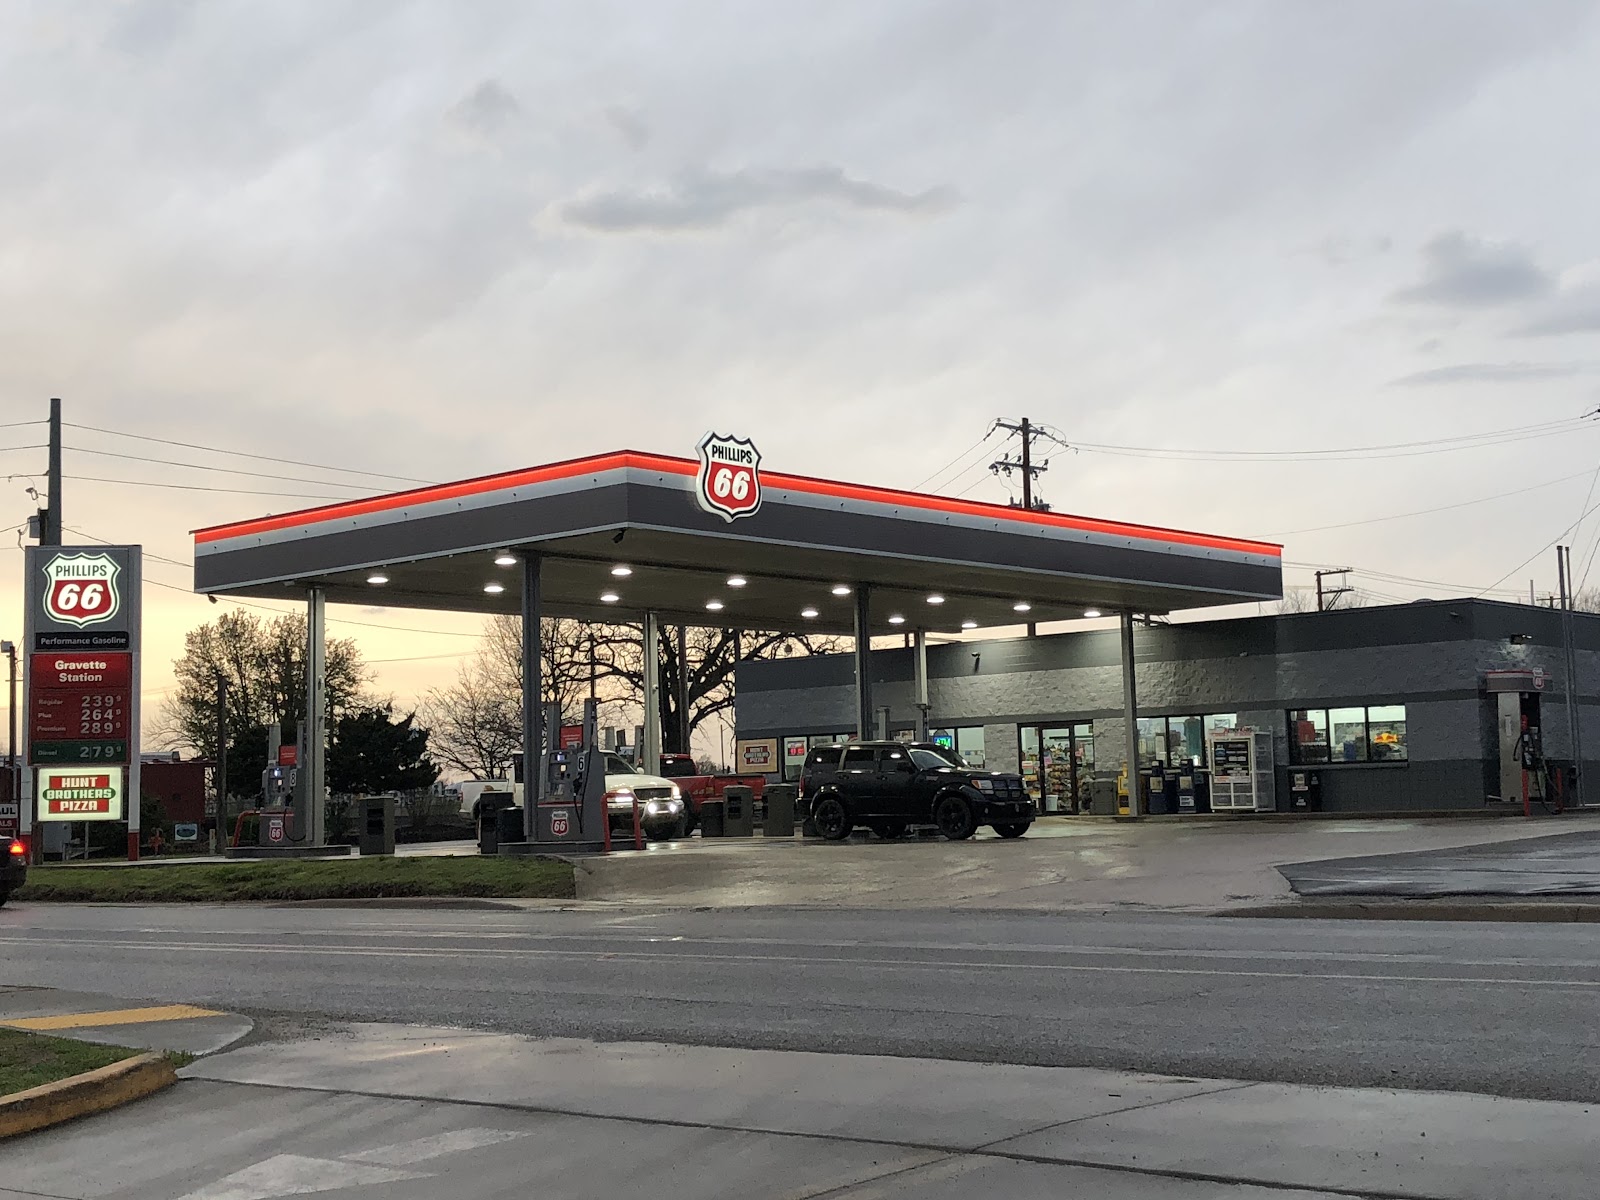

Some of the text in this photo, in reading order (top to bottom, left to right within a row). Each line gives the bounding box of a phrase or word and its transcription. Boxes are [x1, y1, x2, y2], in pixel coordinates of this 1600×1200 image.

[712, 444, 752, 464] PHILLIPS
[714, 468, 750, 500] 66
[56, 565, 107, 577] PHILLIPS
[58, 583, 104, 610] 66
[41, 636, 127, 645] Performance Gasoline
[55, 660, 107, 670] Gravette
[59, 673, 102, 682] Station
[578, 757, 584, 770] 6
[61, 777, 98, 788] HUNT
[46, 788, 112, 799] BROTHERS
[60, 801, 98, 811] PIZZA
[554, 821, 566, 831] 66
[272, 828, 281, 838] 66
